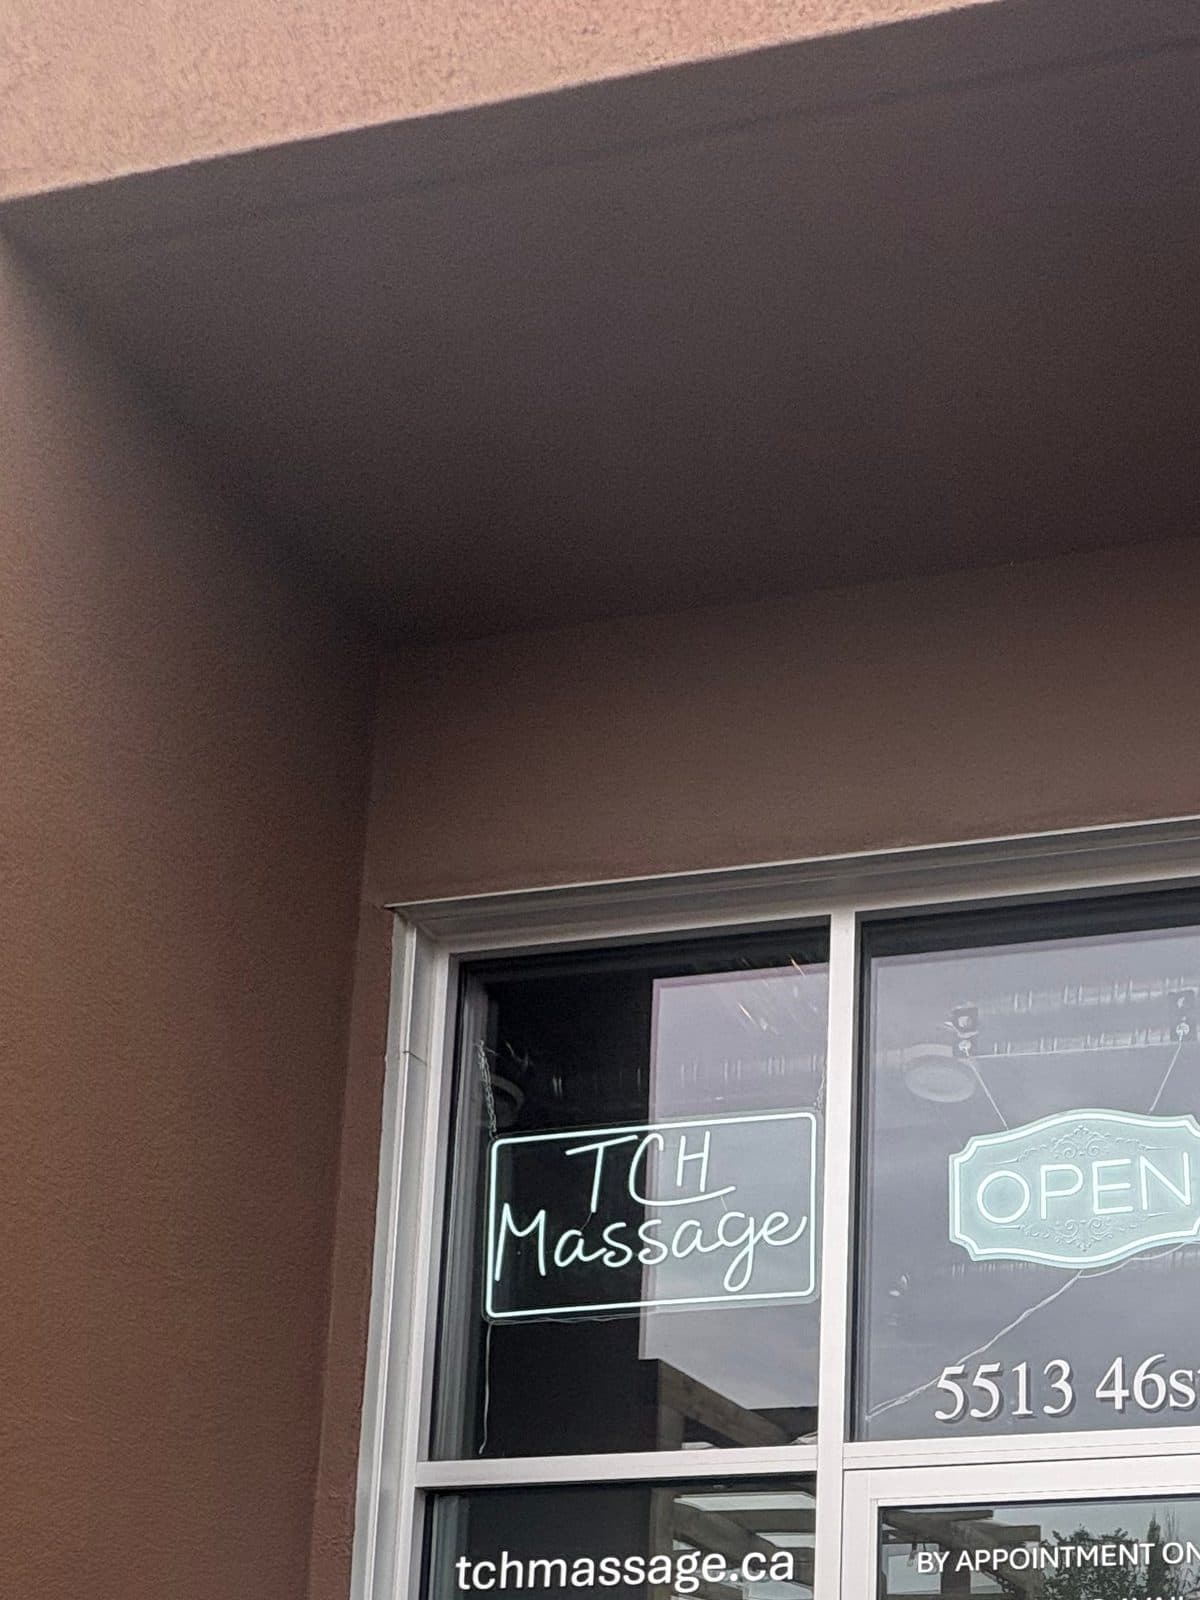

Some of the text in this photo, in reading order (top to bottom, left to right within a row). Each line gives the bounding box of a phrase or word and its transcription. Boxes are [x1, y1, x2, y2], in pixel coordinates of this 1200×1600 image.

[566, 1129, 735, 1214] TCH
[977, 1152, 1191, 1223] OPEN
[494, 1202, 809, 1293] Massage
[935, 1359, 1073, 1420] 5513
[456, 1551, 794, 1592] tchmassage.ca
[918, 1551, 950, 1573] BY
[955, 1543, 1155, 1572] APPOINTMENT
